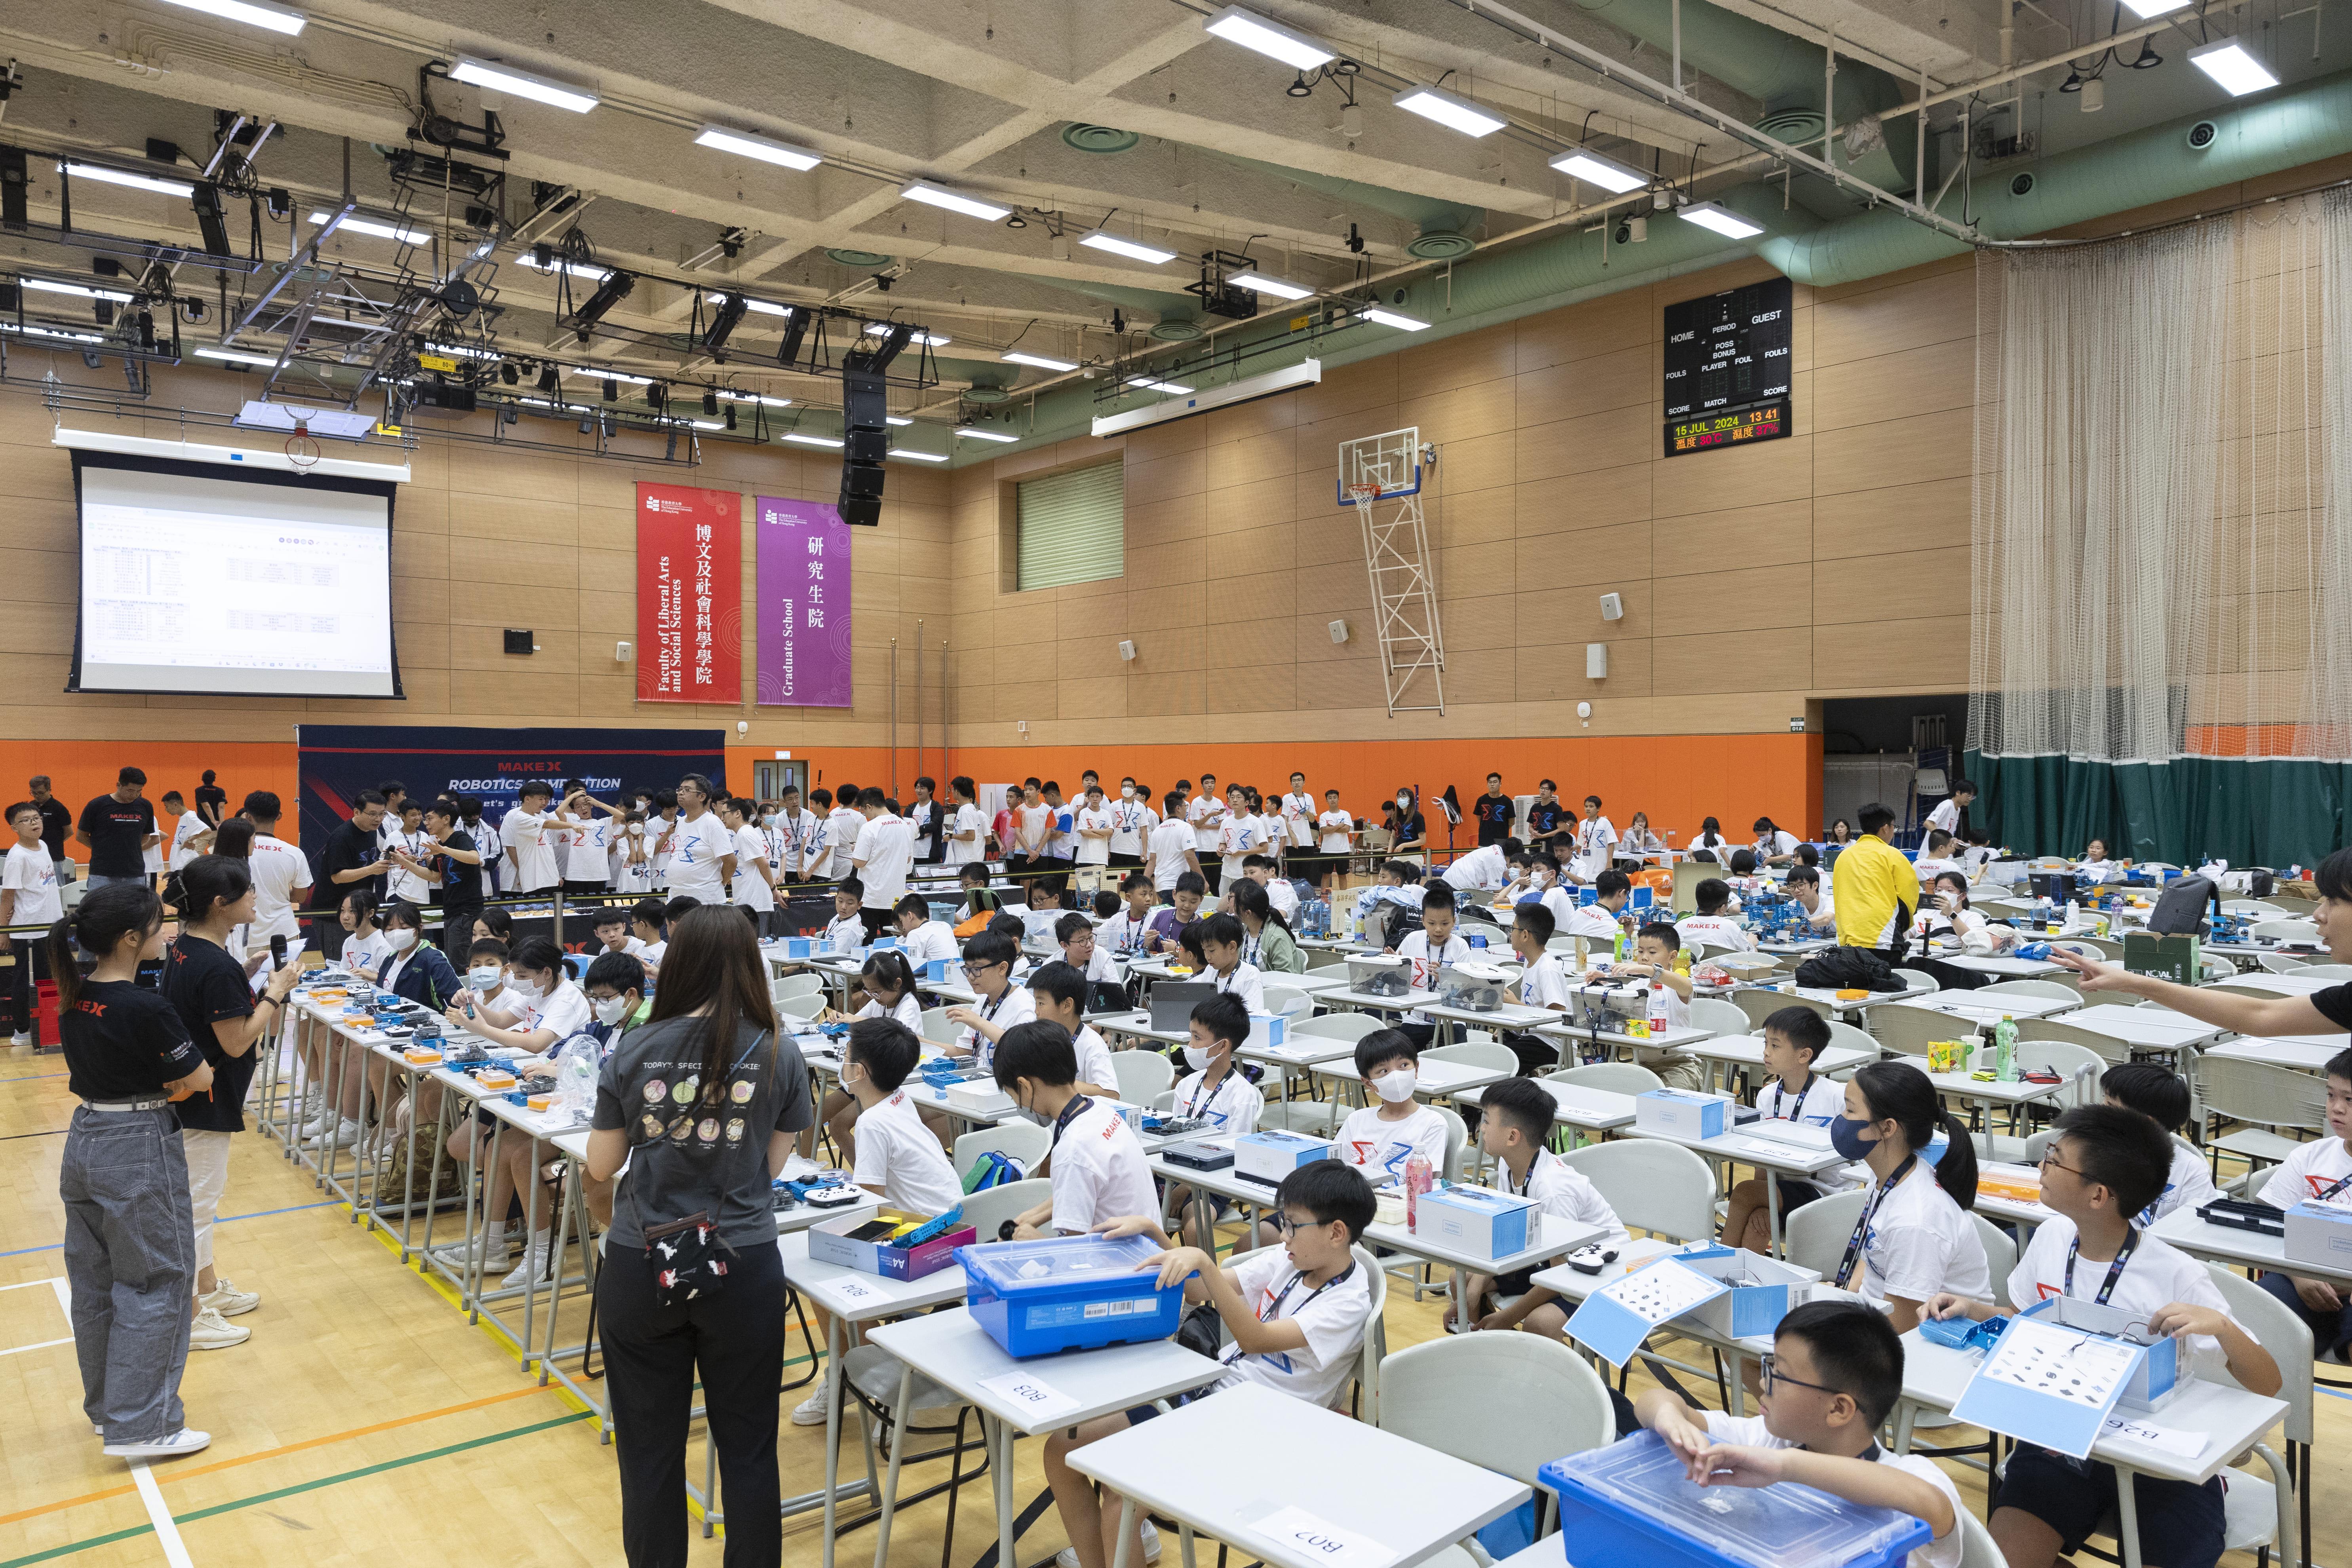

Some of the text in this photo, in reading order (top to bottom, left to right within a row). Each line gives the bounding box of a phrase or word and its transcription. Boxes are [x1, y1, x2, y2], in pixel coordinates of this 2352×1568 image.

[1752, 310, 1782, 324] GUEST
[1713, 323, 1736, 334] PERIOD
[1671, 331, 1694, 343] HOME
[1715, 341, 1734, 350] POSS
[1713, 349, 1736, 359] BONUS
[1765, 348, 1787, 358] FOULS
[1735, 356, 1753, 365] FOUL
[1702, 361, 1727, 372] PLAYER
[1666, 370, 1686, 379] FOULS
[1764, 386, 1787, 396] SCORE
[1704, 398, 1727, 408] MATCH
[1668, 405, 1690, 415] SCORE
[1676, 409, 1777, 436] 15 JUL 2024 13 41
[1756, 422, 1778, 435] 37%
[1676, 438, 1696, 449] 溫度
[808, 537, 824, 628] 研究生院
[696, 524, 712, 684] 博文及社會科學學院
[658, 556, 672, 692] Faculty of Liberal Arts
[670, 579, 681, 692] and Social Sciences
[783, 599, 793, 696] Graduate School
[448, 779, 523, 790] ROBOTICS
[893, 1258, 905, 1269] A4
[842, 1284, 869, 1297] B04
[1014, 1385, 1047, 1401] B03
[2106, 1420, 2159, 1439] B26
[1295, 1531, 1343, 1553] B02
